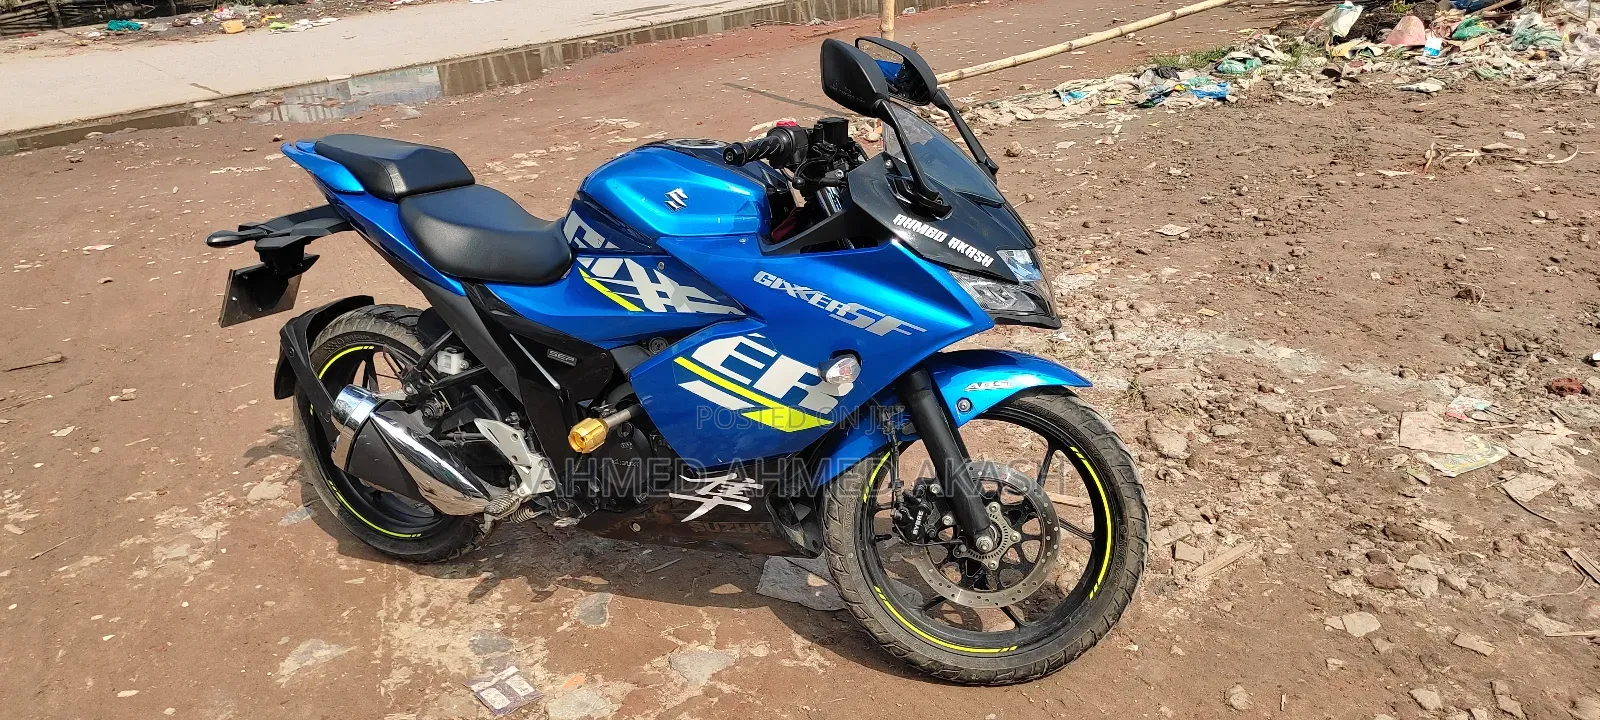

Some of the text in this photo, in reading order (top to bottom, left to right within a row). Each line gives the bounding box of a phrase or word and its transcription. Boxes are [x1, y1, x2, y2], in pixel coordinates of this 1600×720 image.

[892, 213, 995, 268] AHMED AKASH
[752, 270, 851, 317] GIXXER
